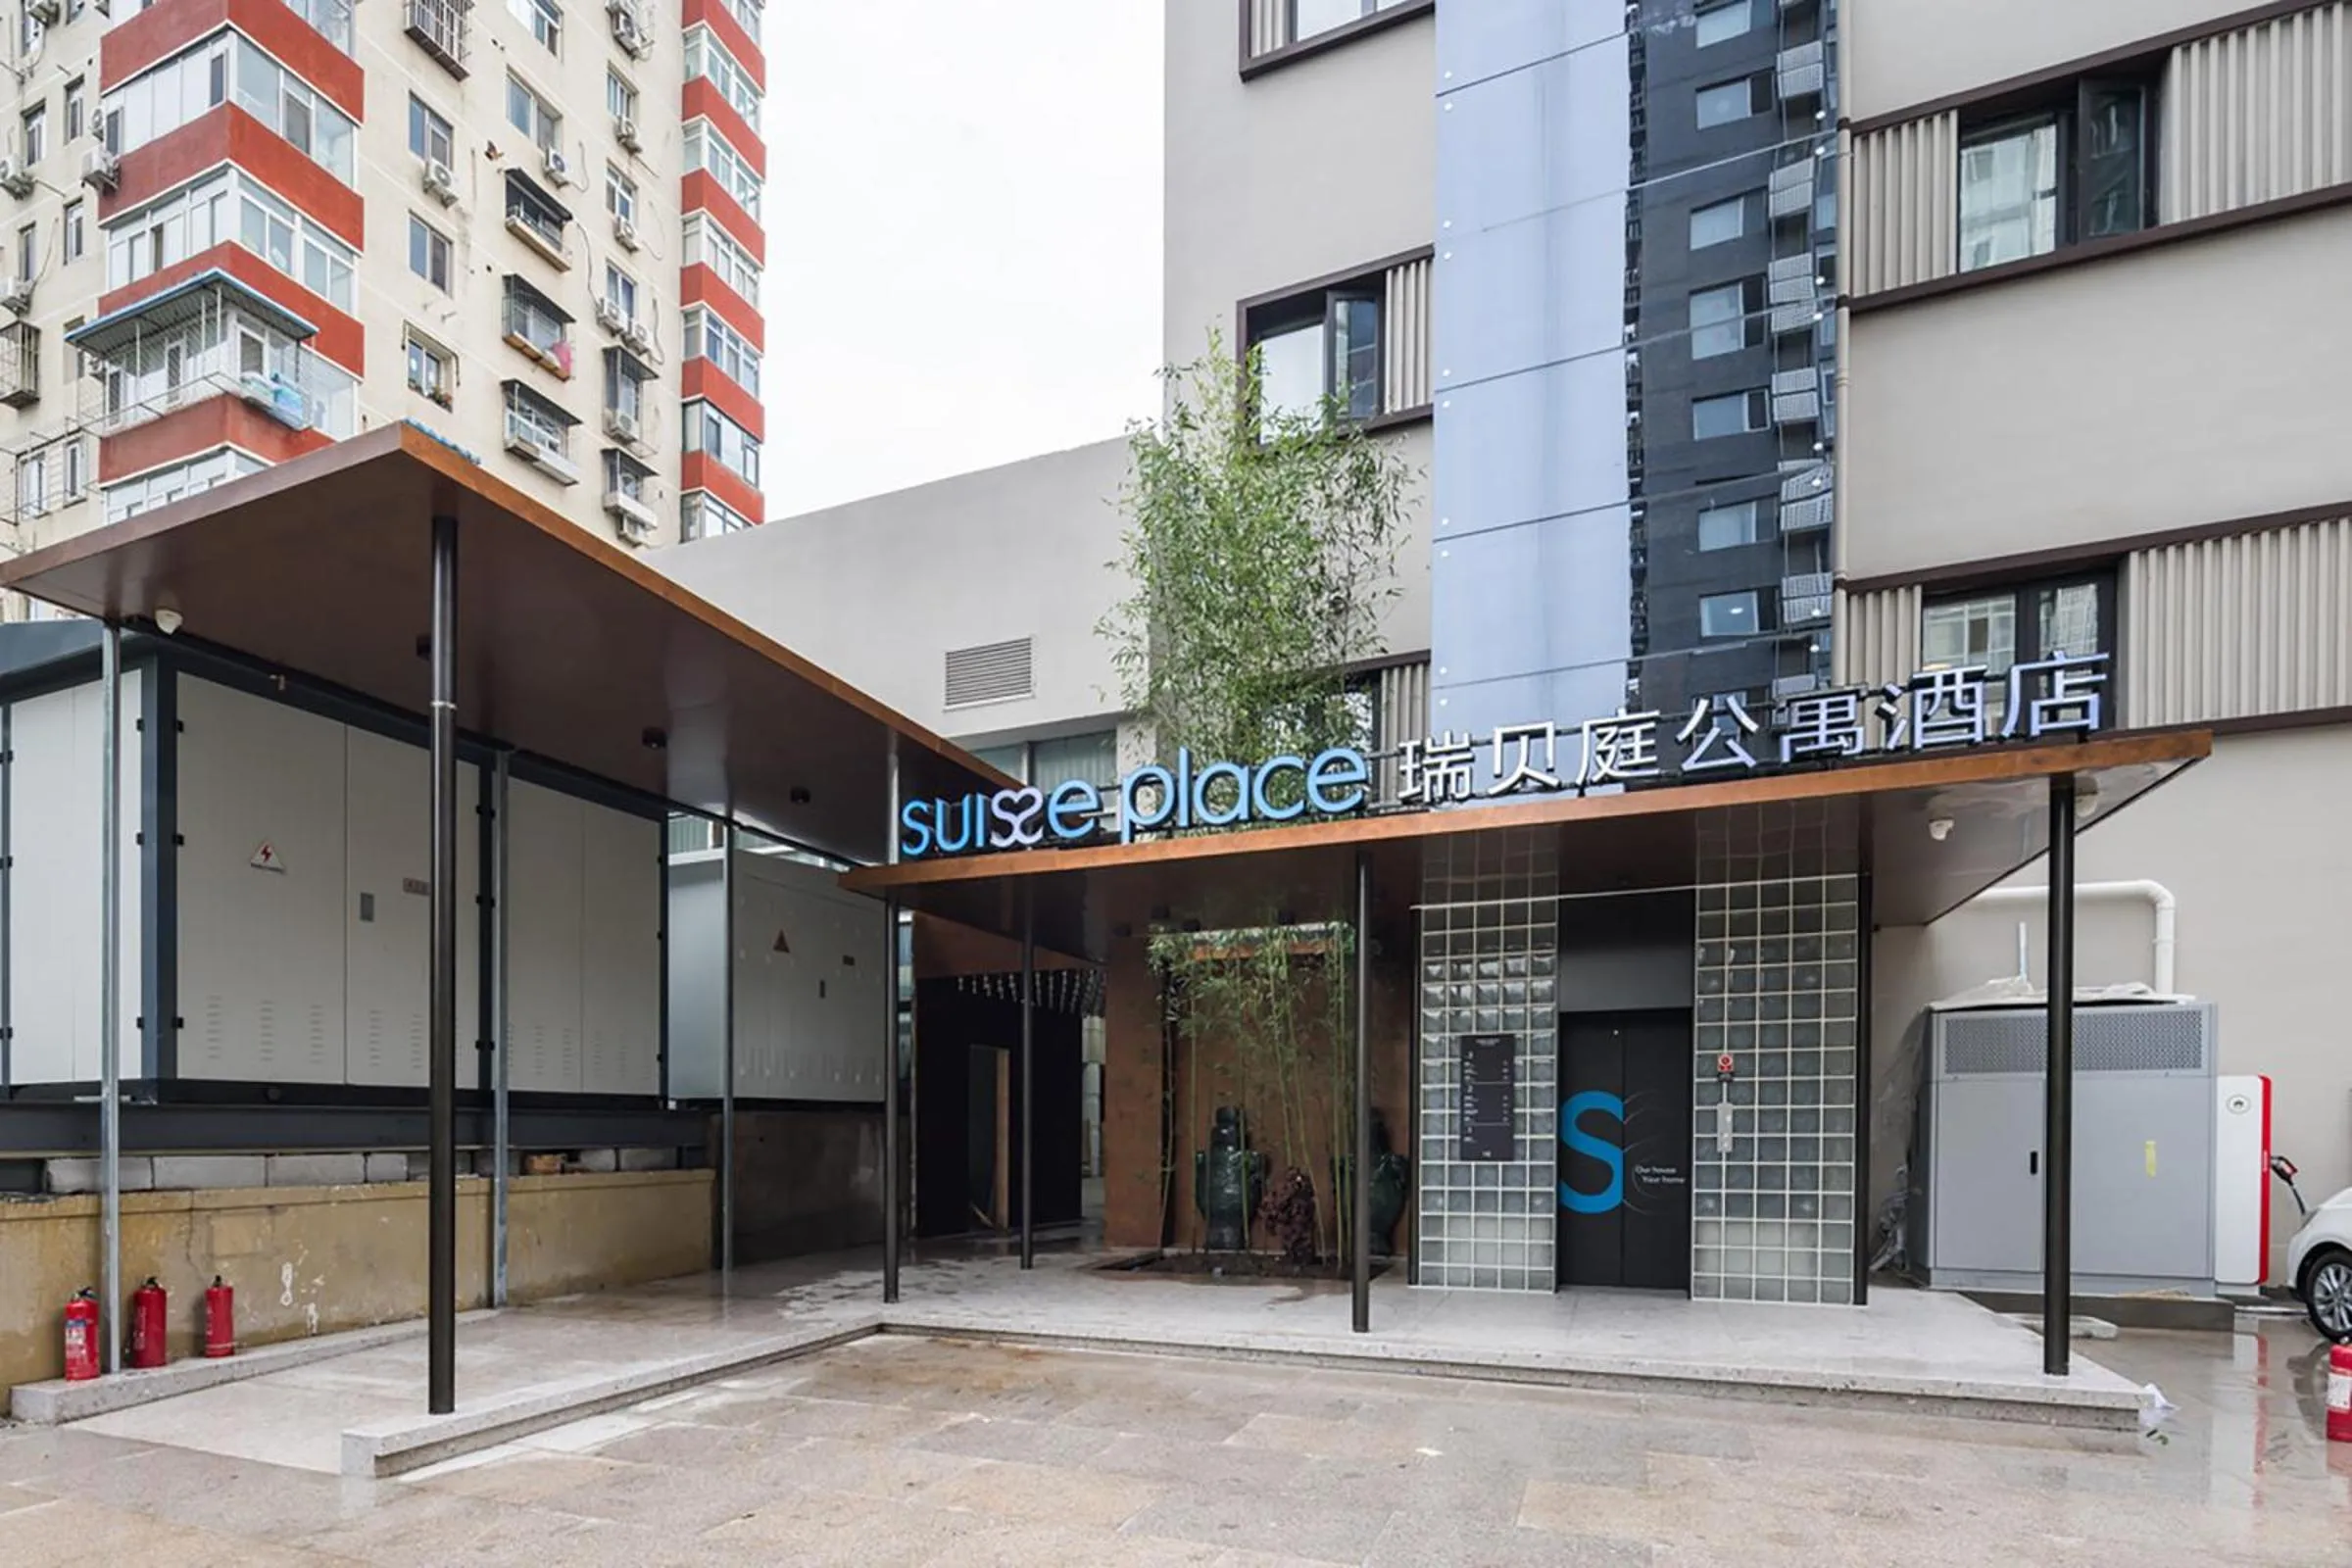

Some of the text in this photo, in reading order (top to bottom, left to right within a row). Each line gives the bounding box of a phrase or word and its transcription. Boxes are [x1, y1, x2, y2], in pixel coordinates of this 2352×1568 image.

[1396, 651, 2109, 806] 瑞贝庭公寓酒店
[1120, 747, 1368, 845] place
